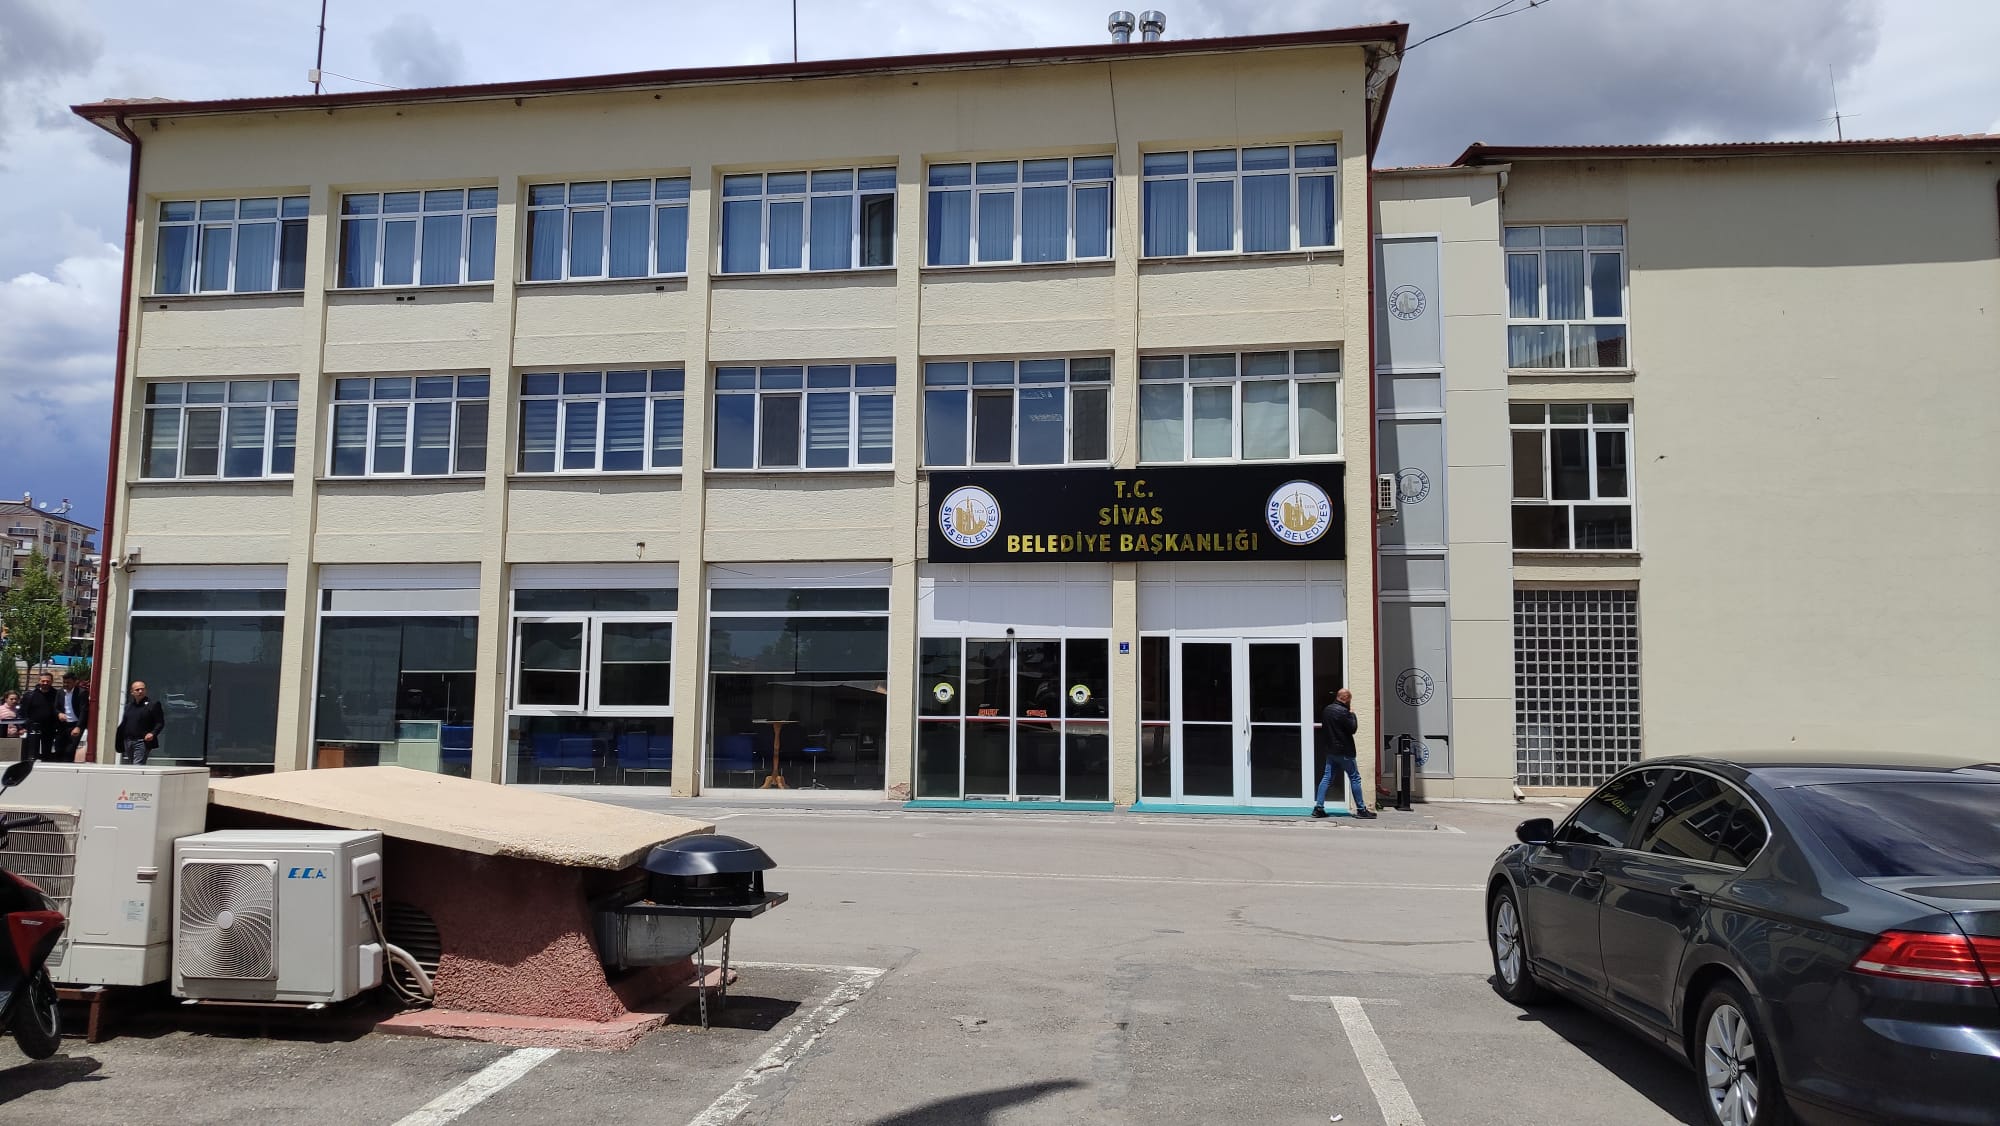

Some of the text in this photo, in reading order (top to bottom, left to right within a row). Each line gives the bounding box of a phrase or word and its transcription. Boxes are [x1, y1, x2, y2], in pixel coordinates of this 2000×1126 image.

[1113, 480, 1153, 498] T.C.
[1099, 504, 1163, 525] SİVAS
[1007, 529, 1258, 555] BELEDİYE BAŞKANLIĞI
